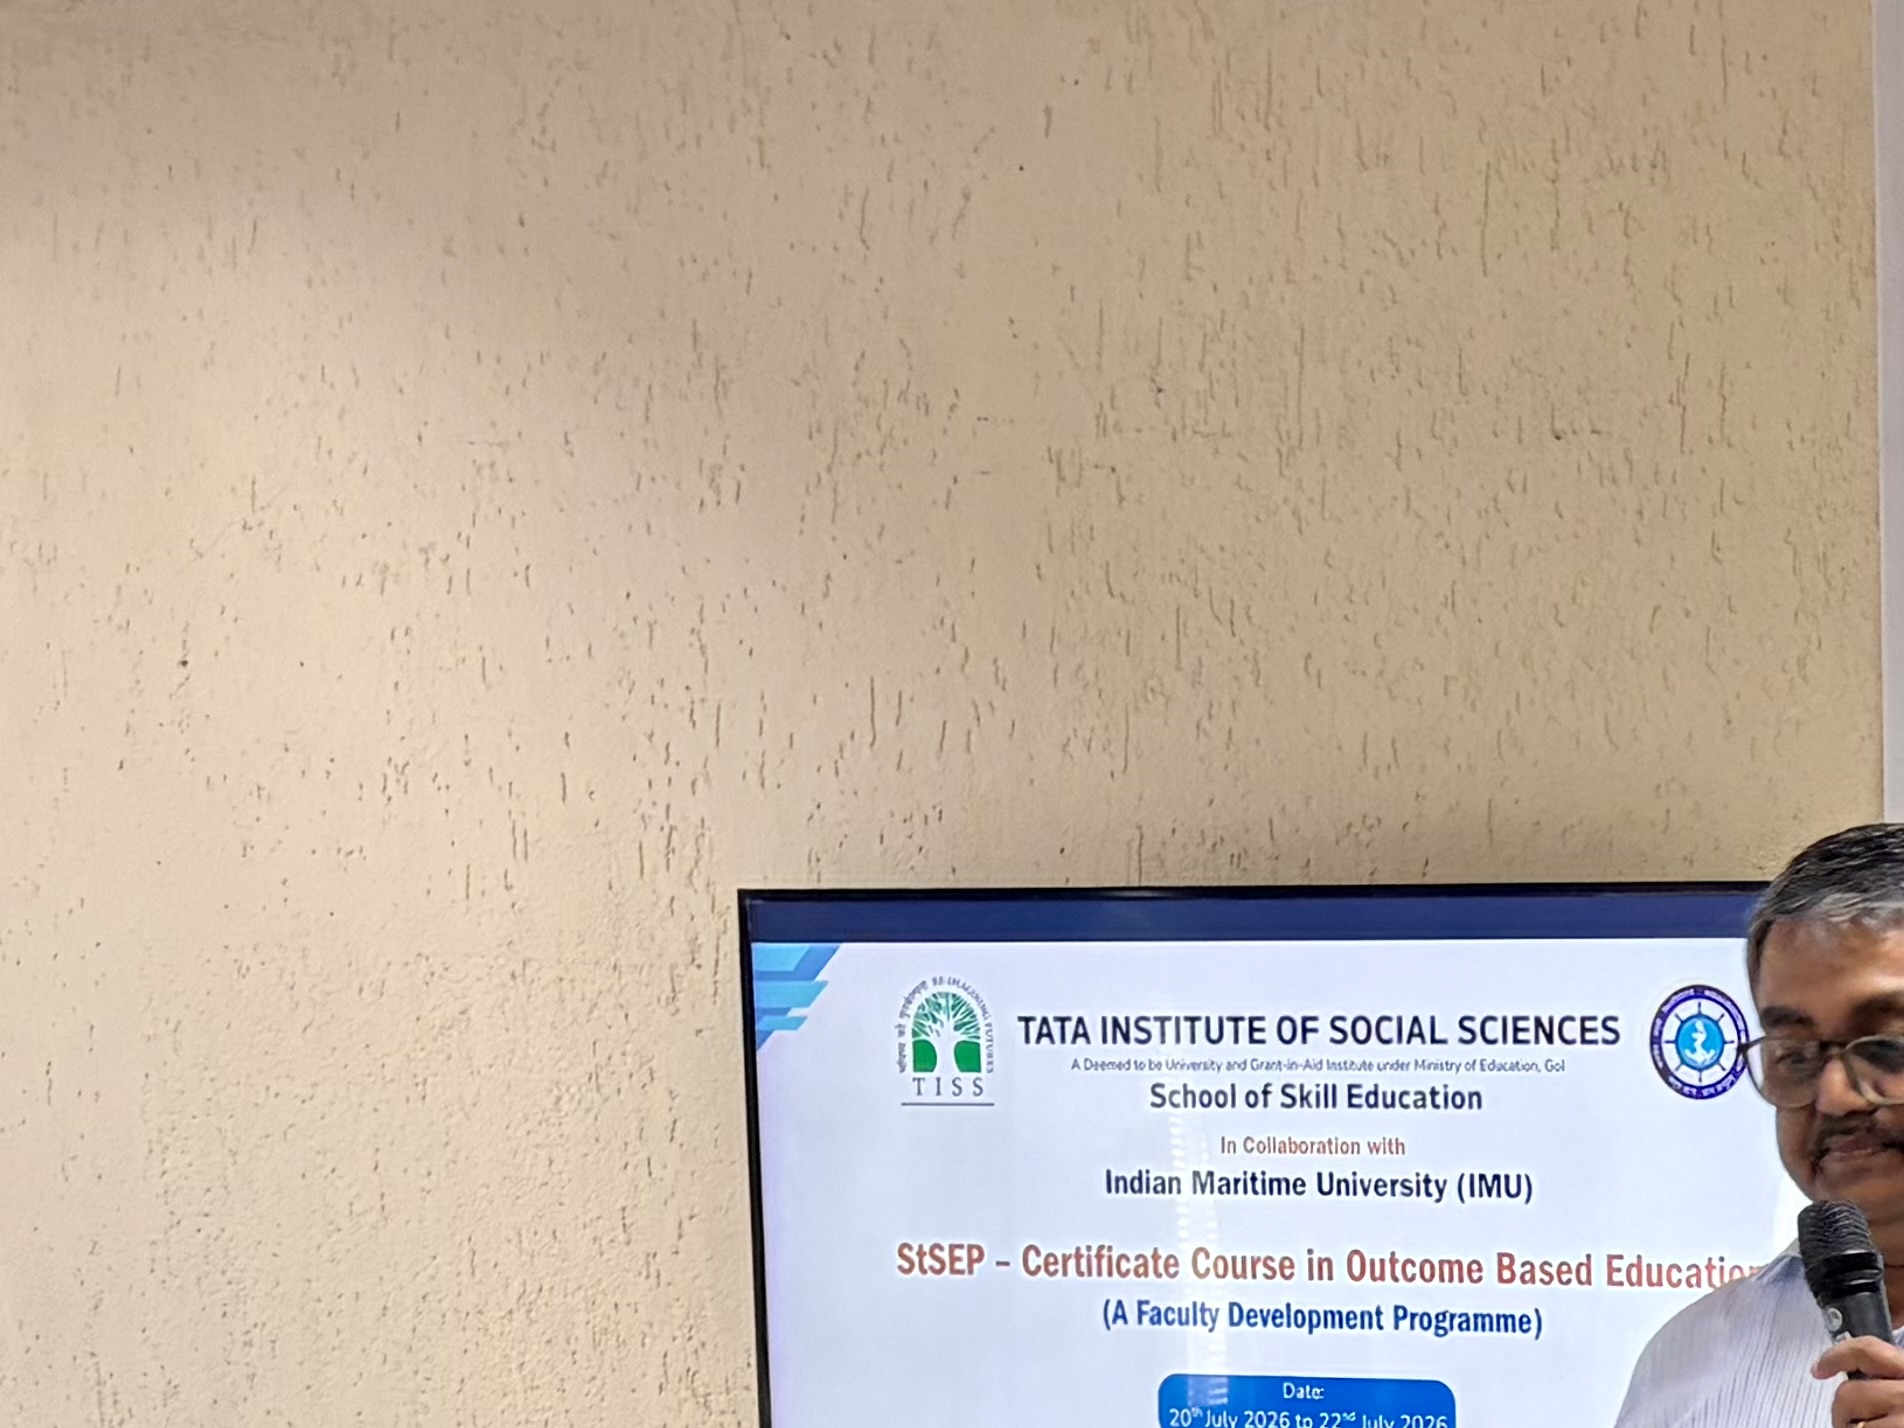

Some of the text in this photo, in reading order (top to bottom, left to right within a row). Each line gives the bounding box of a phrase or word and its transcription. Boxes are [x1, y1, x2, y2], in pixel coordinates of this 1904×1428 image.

[1018, 1015, 1622, 1046] TATA INSTITUTE OF SOCIAL SCIENCES
[1071, 1058, 1081, 1071] A
[1134, 1058, 1146, 1071] to
[1148, 1058, 1162, 1072] be
[1165, 1058, 1222, 1073] University
[1225, 1058, 1247, 1072] and
[1250, 1058, 1323, 1072] Grant-in-Aid
[1326, 1059, 1374, 1072] Institute
[1377, 1059, 1410, 1072] under
[1413, 1059, 1461, 1075] Ministry
[1464, 1059, 1475, 1072] of
[912, 1076, 984, 1097] TISS
[1150, 1082, 1482, 1110] School of Skill Education
[1221, 1137, 1406, 1156] In Collaboration with
[1105, 1169, 1533, 1204] Indian Maritime University (IMU)
[897, 1243, 985, 1275] StSEP
[1022, 1244, 1180, 1278] Certificate
[1191, 1247, 1295, 1280] Course
[1307, 1249, 1334, 1282] in
[1346, 1249, 1484, 1284] Outcome
[1497, 1252, 1593, 1286] Based
[1103, 1299, 1543, 1339] (A Faculty Development Programme)
